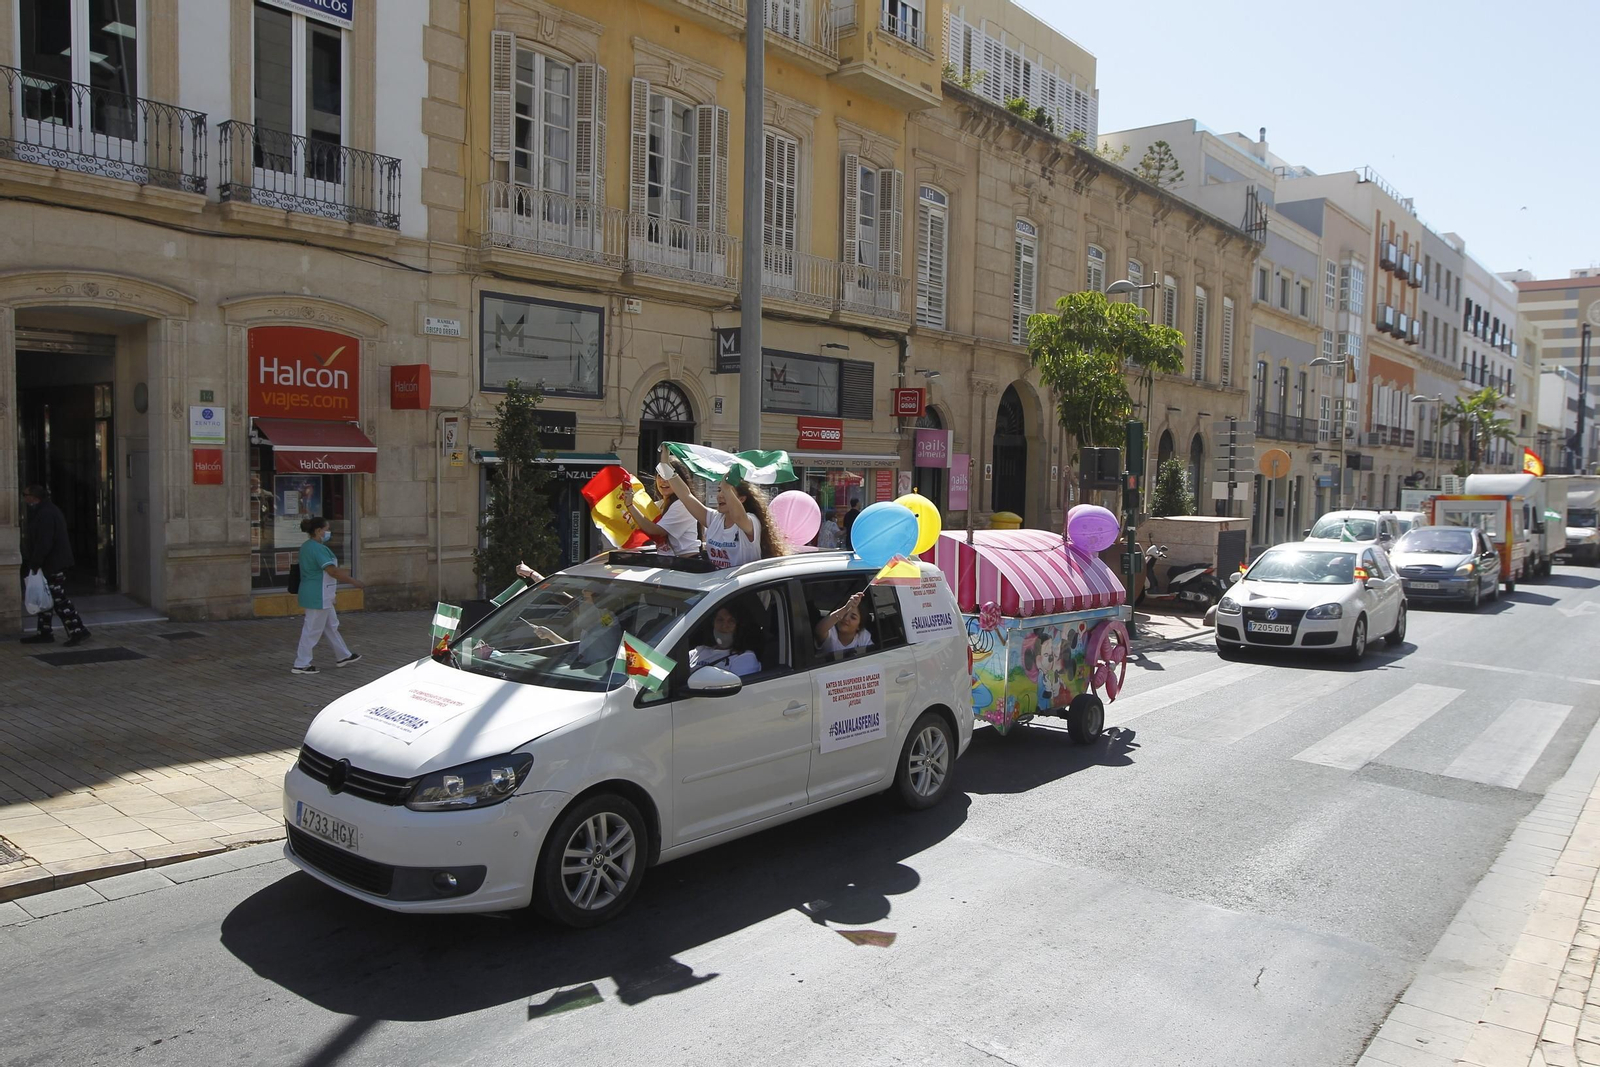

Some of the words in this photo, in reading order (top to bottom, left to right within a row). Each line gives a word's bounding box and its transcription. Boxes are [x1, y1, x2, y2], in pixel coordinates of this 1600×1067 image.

[925, 188, 934, 200] LH
[426, 326, 442, 334] OBISPO
[261, 391, 348, 410] viajes.com
[538, 426, 576, 434] NZALEZ
[820, 430, 840, 440] FOTO
[918, 440, 946, 450] nails
[951, 474, 968, 484] nails
[1252, 623, 1272, 631] 7205
[1274, 624, 1290, 632] GHX
[843, 676, 862, 686] SUSPENDER
[866, 674, 880, 682] APLAZAR
[838, 692, 861, 701] ATRACCIONES
[829, 712, 880, 736] #SALVALASFERIAS
[302, 808, 328, 834] 4733
[332, 820, 356, 847] HGY
